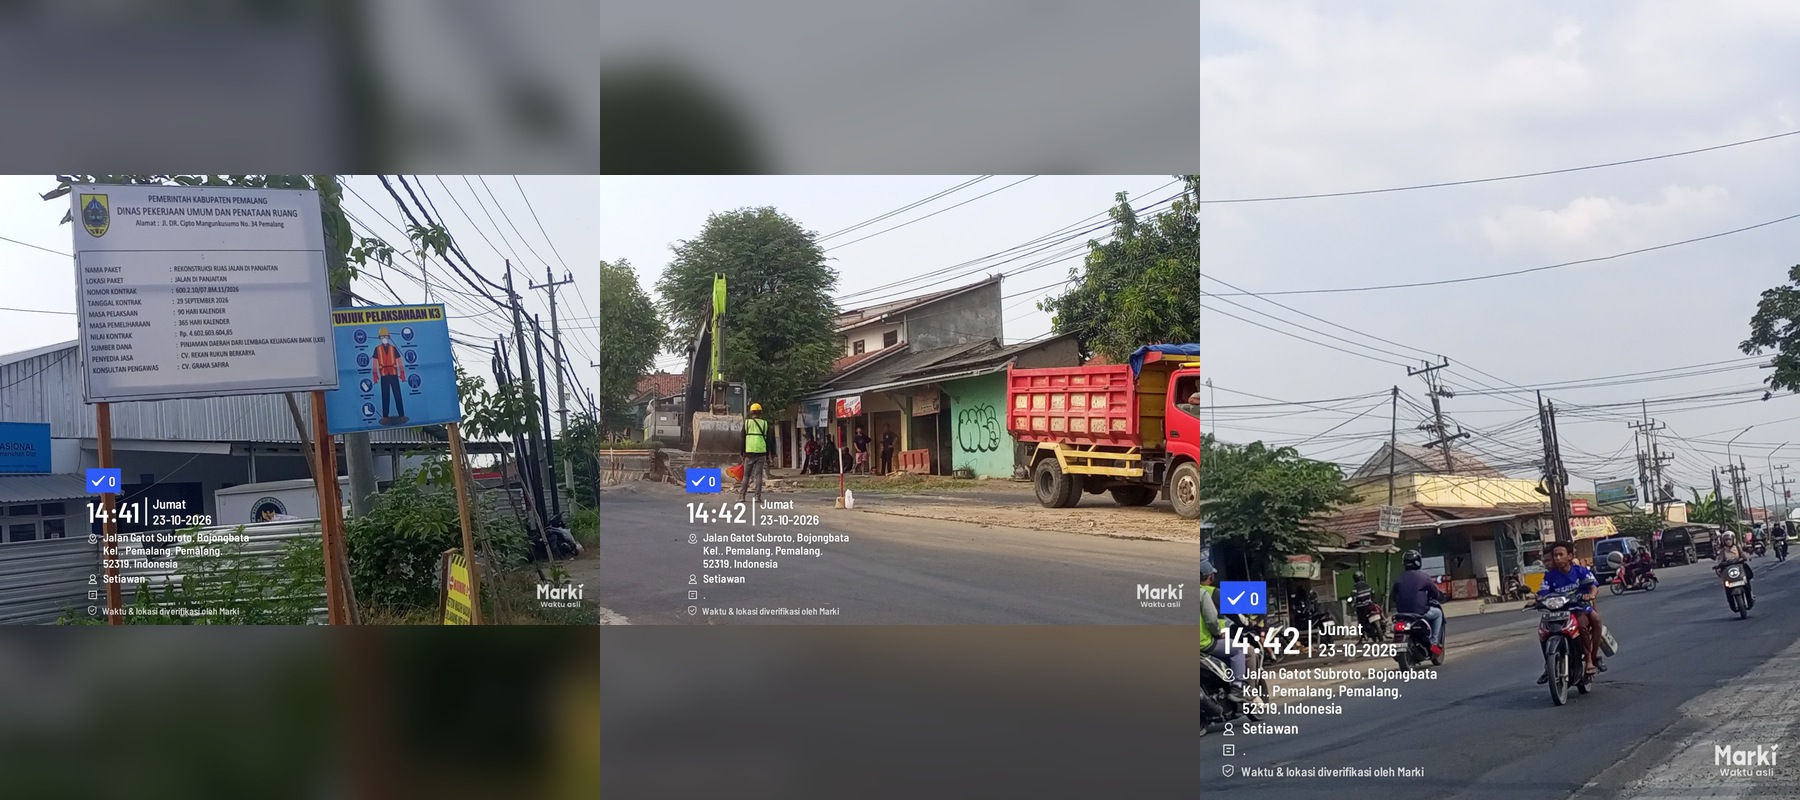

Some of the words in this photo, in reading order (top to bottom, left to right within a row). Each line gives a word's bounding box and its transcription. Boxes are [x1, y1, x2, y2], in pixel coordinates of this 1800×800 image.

[148, 195, 191, 203] PEMERINTAH
[192, 196, 231, 204] KABUPATEN
[116, 207, 141, 215] DINAS
[142, 207, 185, 216] PEKERJAAN
[187, 208, 213, 216] UMUM
[215, 208, 231, 216] DAN
[232, 209, 271, 217] PENATAAN
[273, 209, 298, 217] RUANG
[196, 220, 239, 228] Mangunkusumo
[365, 309, 427, 322] PELAKSANAAN
[428, 307, 441, 319] K3
[93, 366, 126, 374] KONSULTAN
